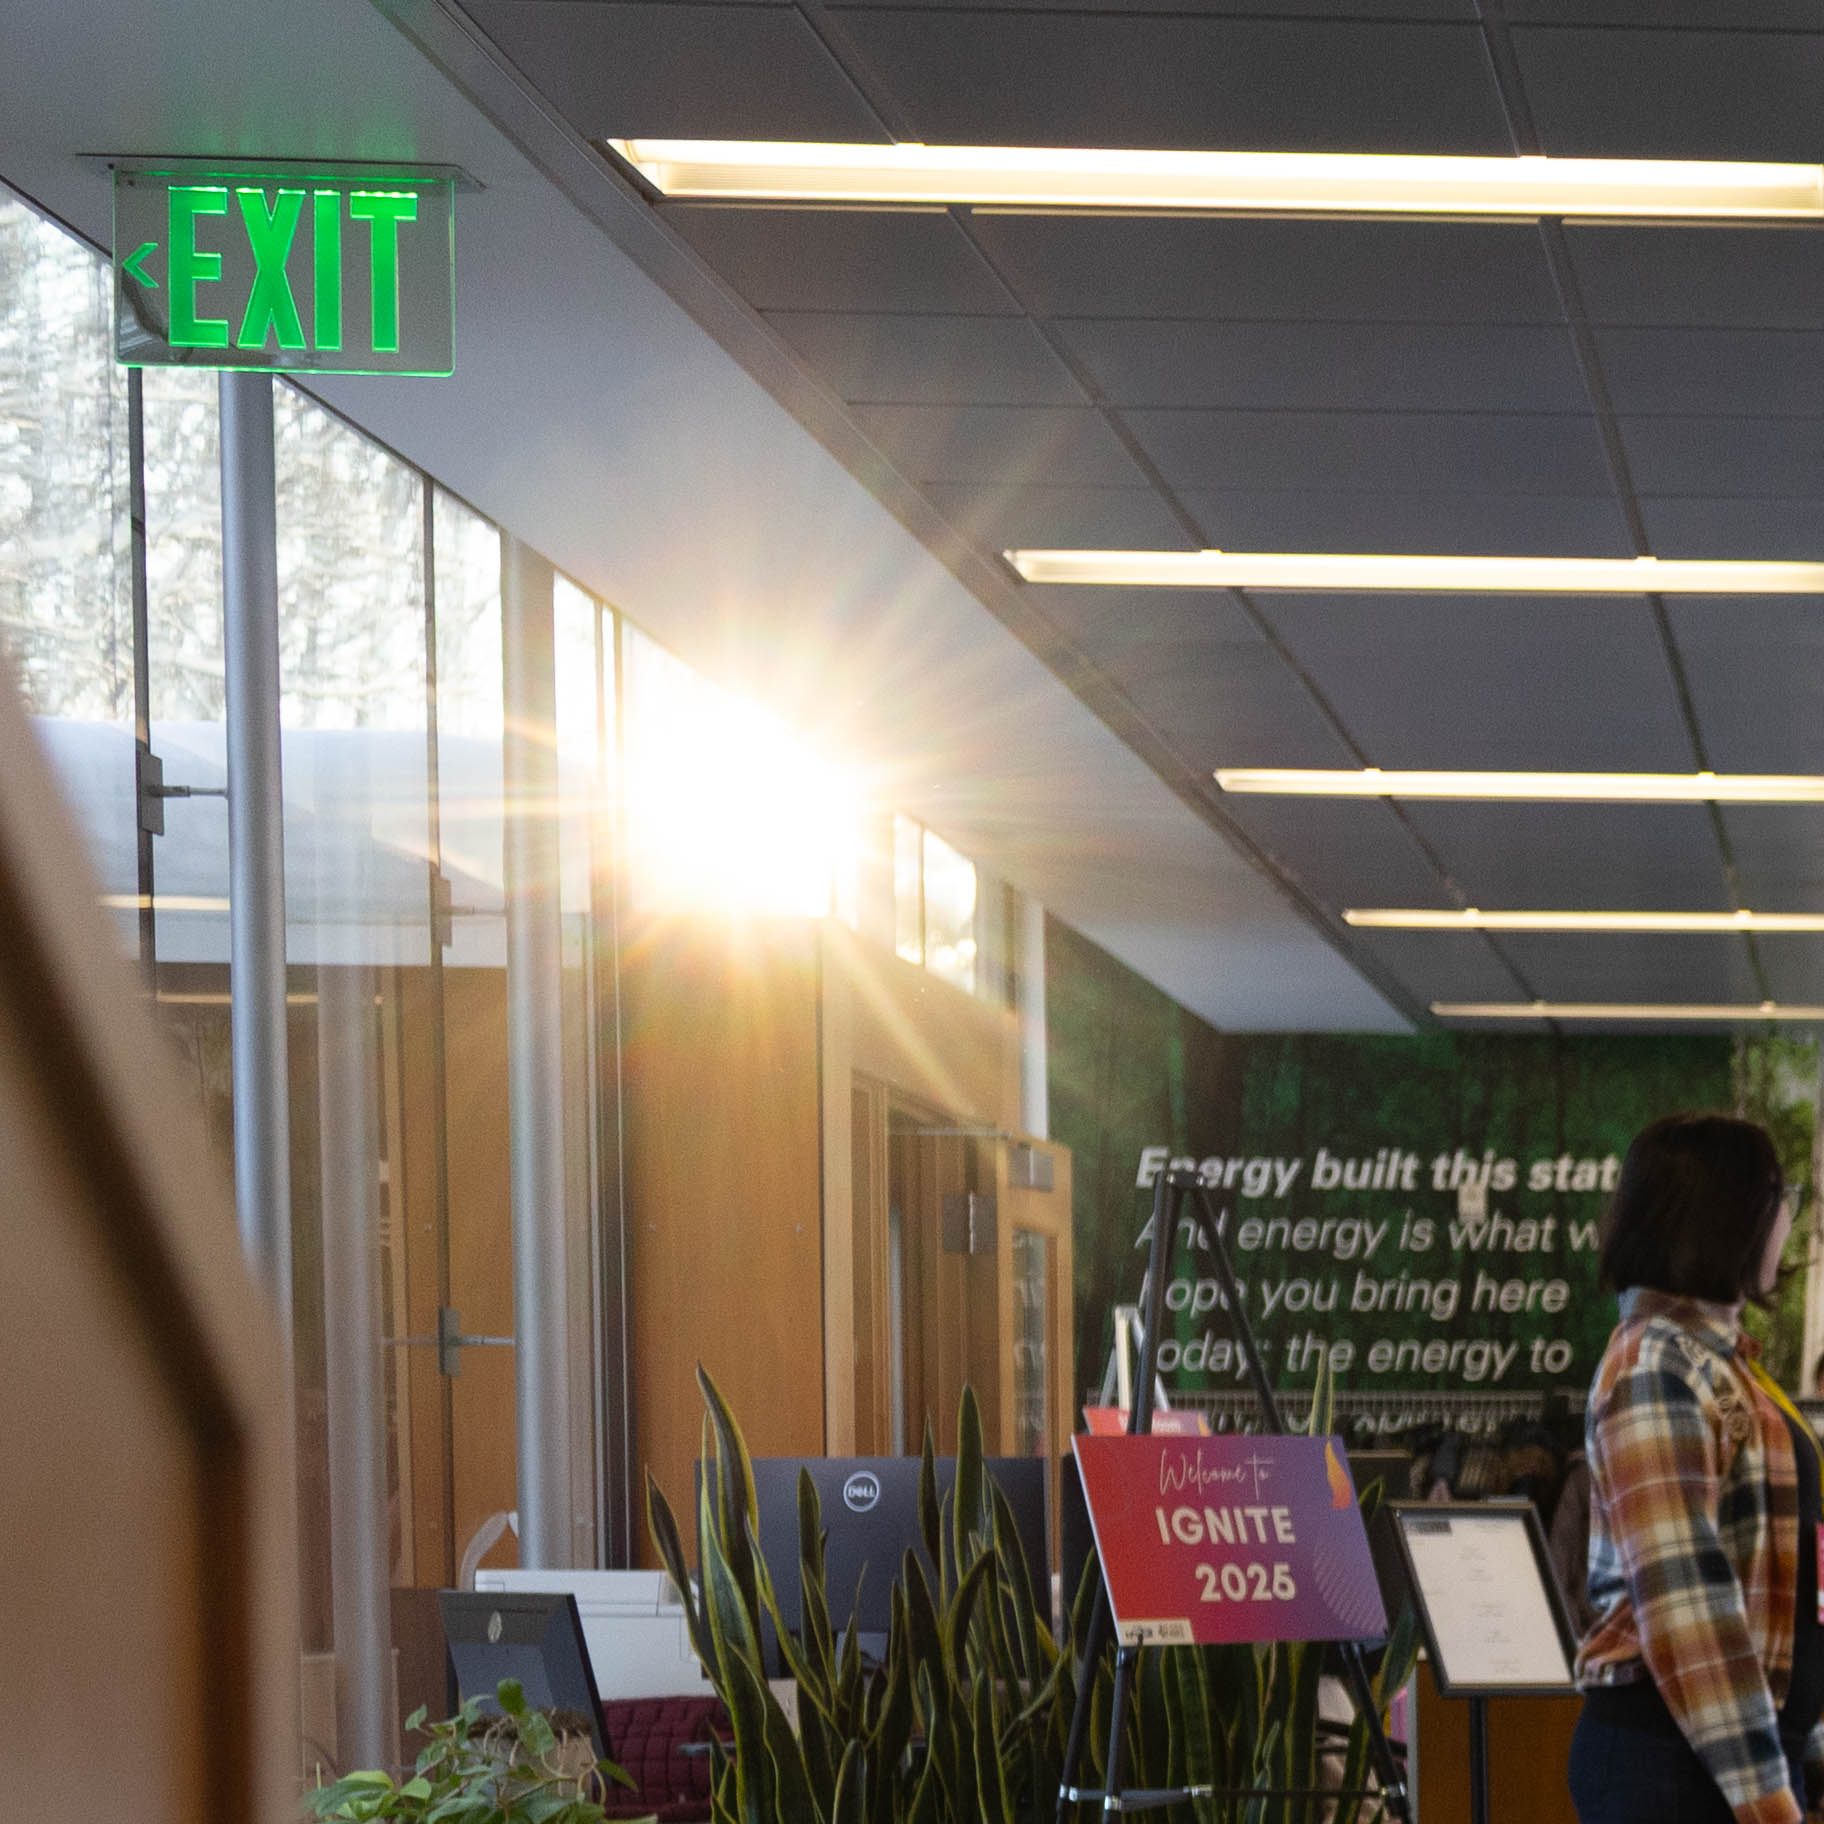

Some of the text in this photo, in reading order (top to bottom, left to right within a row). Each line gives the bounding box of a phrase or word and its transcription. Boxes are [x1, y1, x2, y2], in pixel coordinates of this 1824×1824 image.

[168, 186, 418, 352] EXIT
[1311, 1147, 1420, 1191] built
[1432, 1148, 1517, 1191] this
[1528, 1152, 1621, 1192] stat
[1237, 1217, 1388, 1260] energy
[1400, 1208, 1435, 1251] is
[1449, 1209, 1555, 1251] what
[1261, 1278, 1338, 1319] you
[1351, 1268, 1460, 1321] bring
[1471, 1268, 1570, 1313] here
[1286, 1330, 1356, 1372] the
[1368, 1339, 1519, 1382] energy
[1530, 1334, 1574, 1373] to
[848, 1484, 875, 1498] DELL
[1159, 1448, 1246, 1497] Welcome
[1155, 1505, 1297, 1545] IGNITE
[1195, 1562, 1297, 1602] 2025
